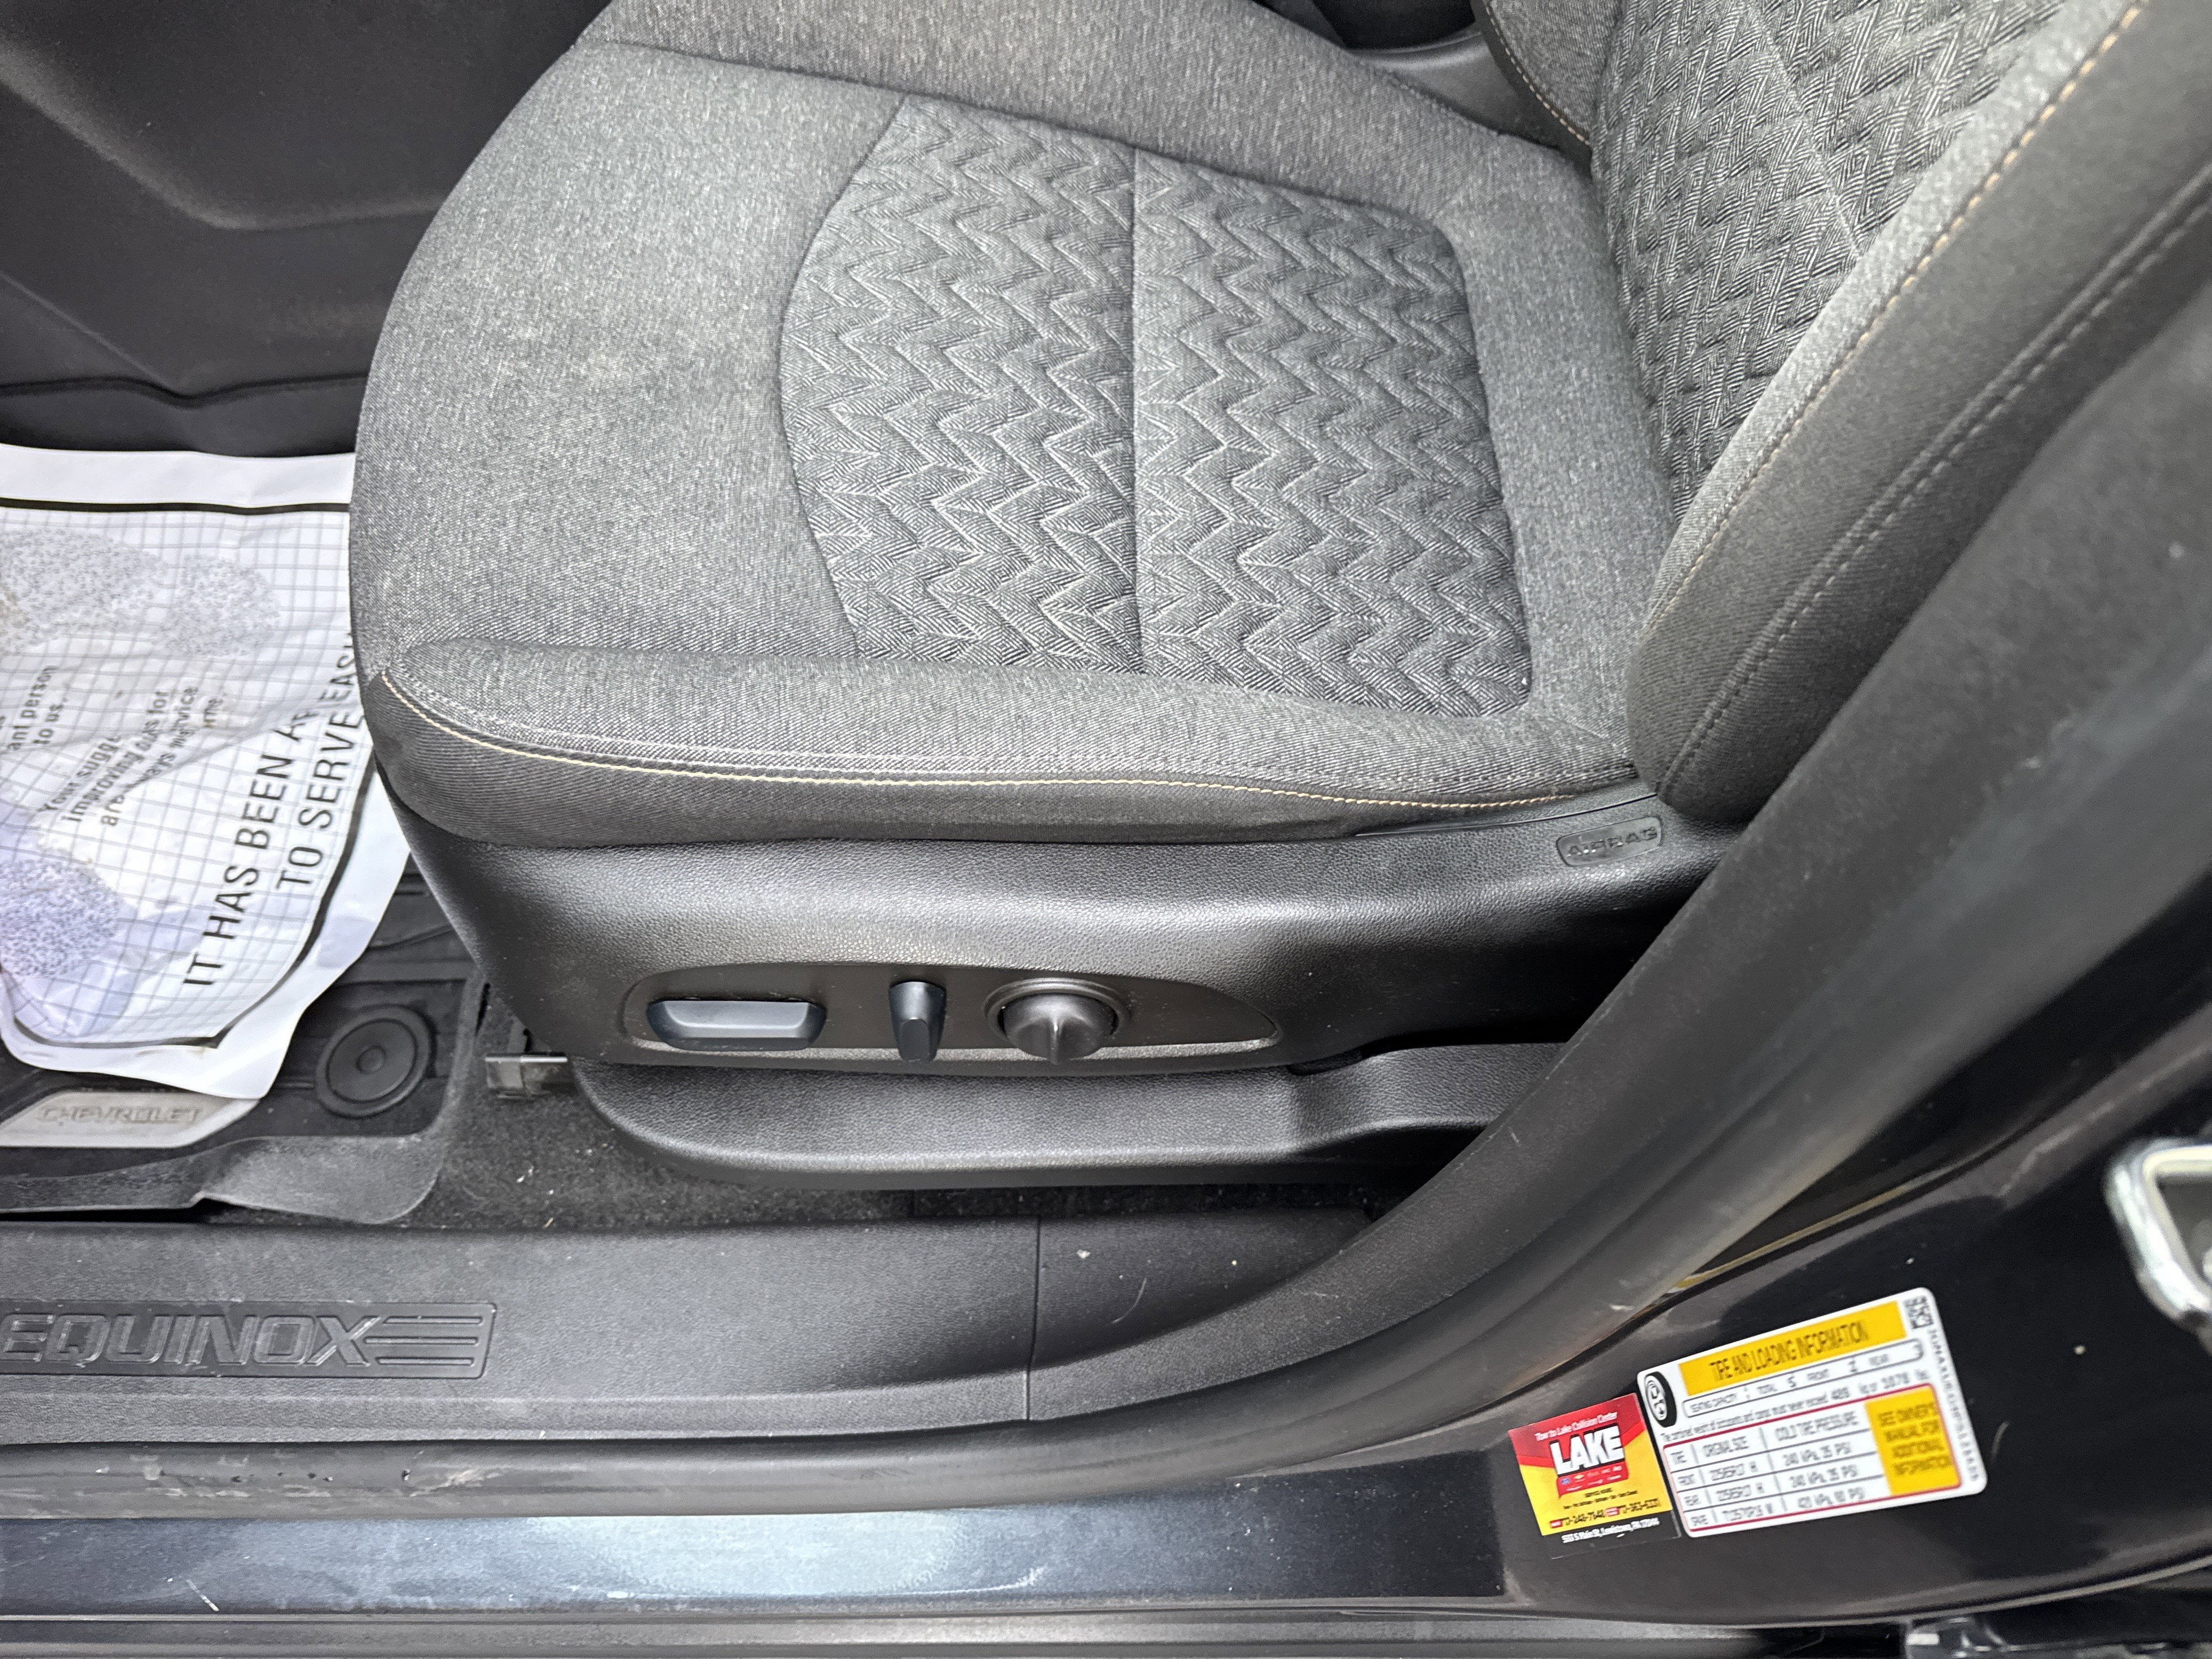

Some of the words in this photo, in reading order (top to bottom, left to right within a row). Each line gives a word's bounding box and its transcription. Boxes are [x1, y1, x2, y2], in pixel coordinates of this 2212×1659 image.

[20, 665, 58, 719] person
[297, 712, 365, 830] SERVE
[235, 753, 294, 850] BEEN
[275, 845, 324, 891] TO
[202, 865, 259, 940] HAS
[183, 951, 224, 986] IT
[38, 1103, 203, 1125] CHEVROLET
[0, 1313, 385, 1368] EQUINOX
[1709, 1359, 1732, 1380] TIRE
[1731, 1353, 1753, 1374] AND
[1751, 1340, 1798, 1369] LOADING
[1796, 1321, 1869, 1357] INFORMATION
[1549, 1424, 1626, 1476] LAKE
